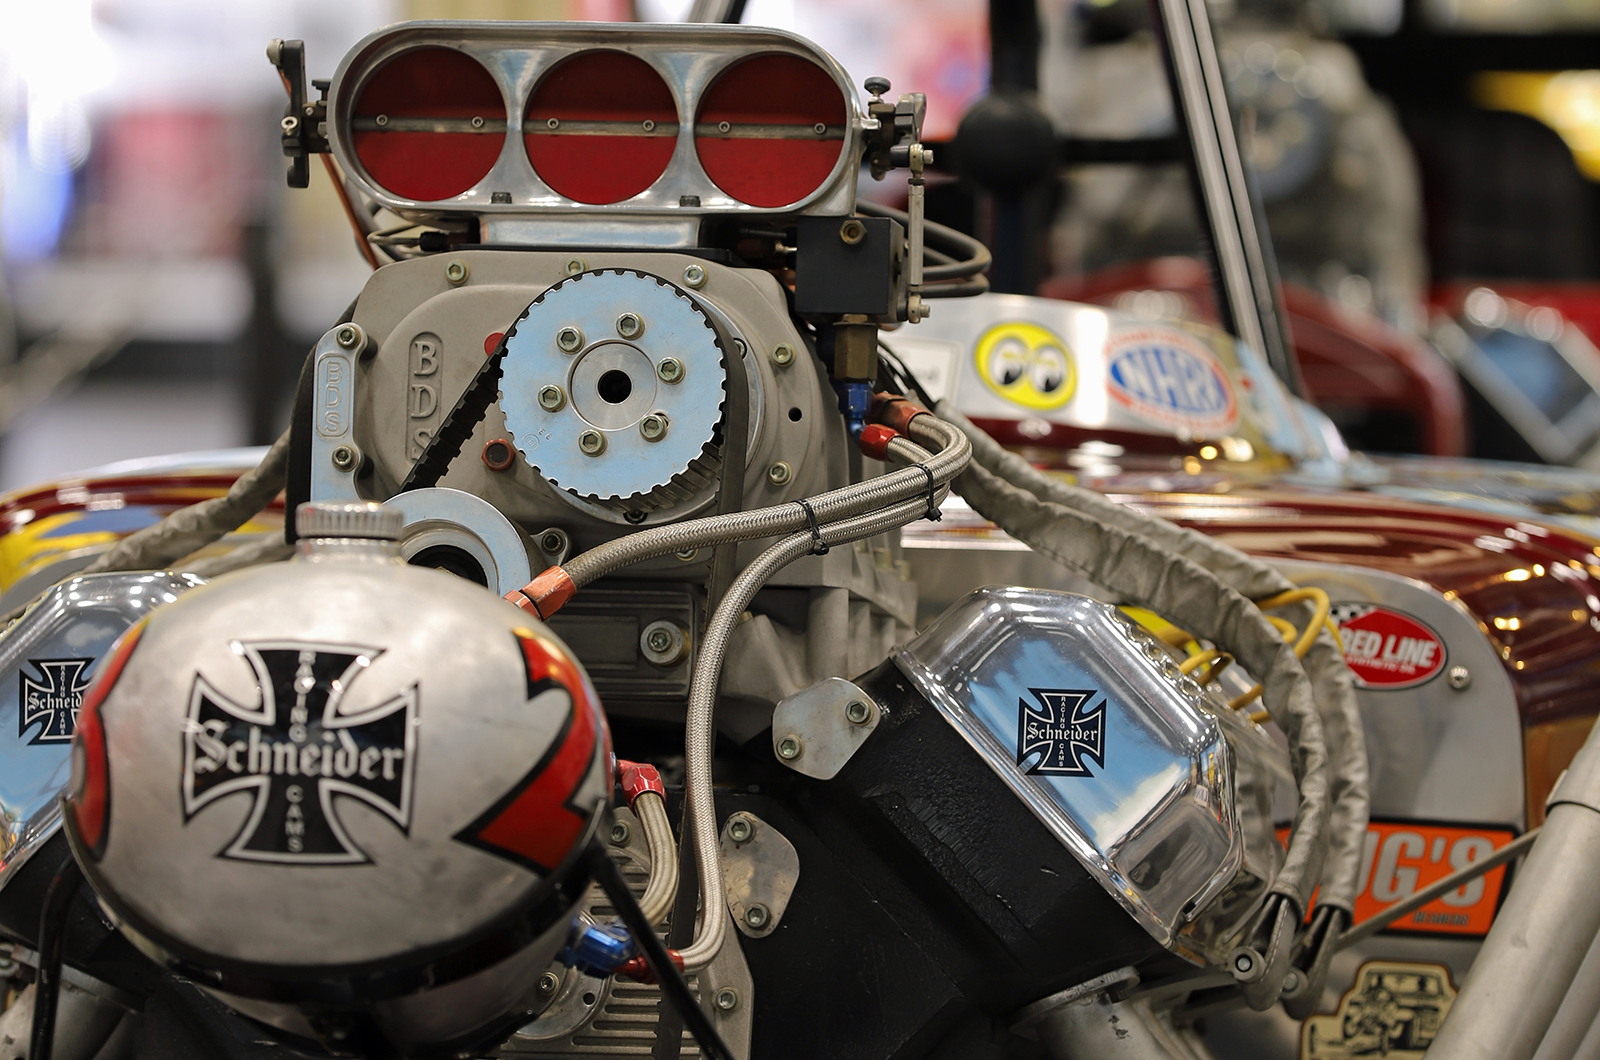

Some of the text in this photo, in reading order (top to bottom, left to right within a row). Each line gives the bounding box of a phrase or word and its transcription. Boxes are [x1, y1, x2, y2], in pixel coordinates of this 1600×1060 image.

[324, 360, 343, 434] BDS
[1339, 626, 1439, 669] RED LINE
[28, 691, 86, 712] Schneid
[1059, 695, 1067, 729] RACING
[191, 717, 405, 782] Schneider
[1026, 721, 1098, 741] Schneider
[285, 784, 306, 853] CAMS
